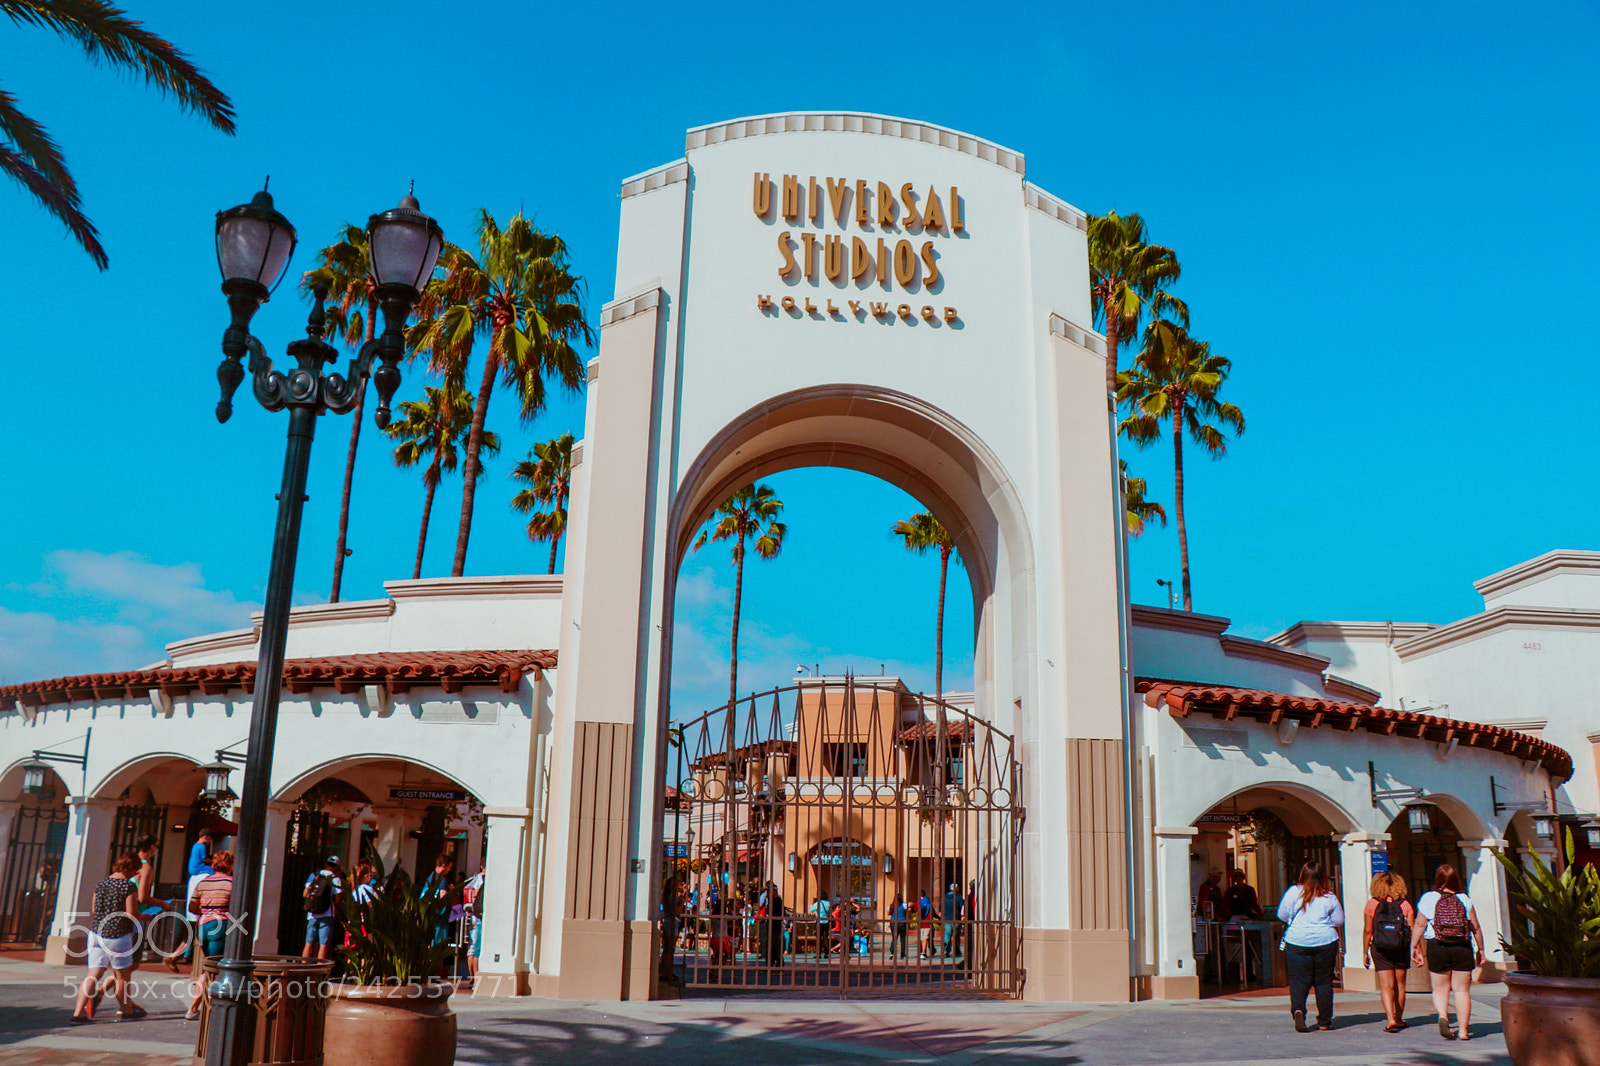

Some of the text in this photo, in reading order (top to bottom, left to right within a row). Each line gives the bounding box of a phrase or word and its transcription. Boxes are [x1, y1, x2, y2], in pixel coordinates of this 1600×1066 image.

[753, 172, 963, 230] UNIVERSAL
[777, 231, 939, 286] STUDIOS
[757, 294, 958, 322] HOLLYWOOD
[397, 790, 454, 799] GUEST ENTRANCE
